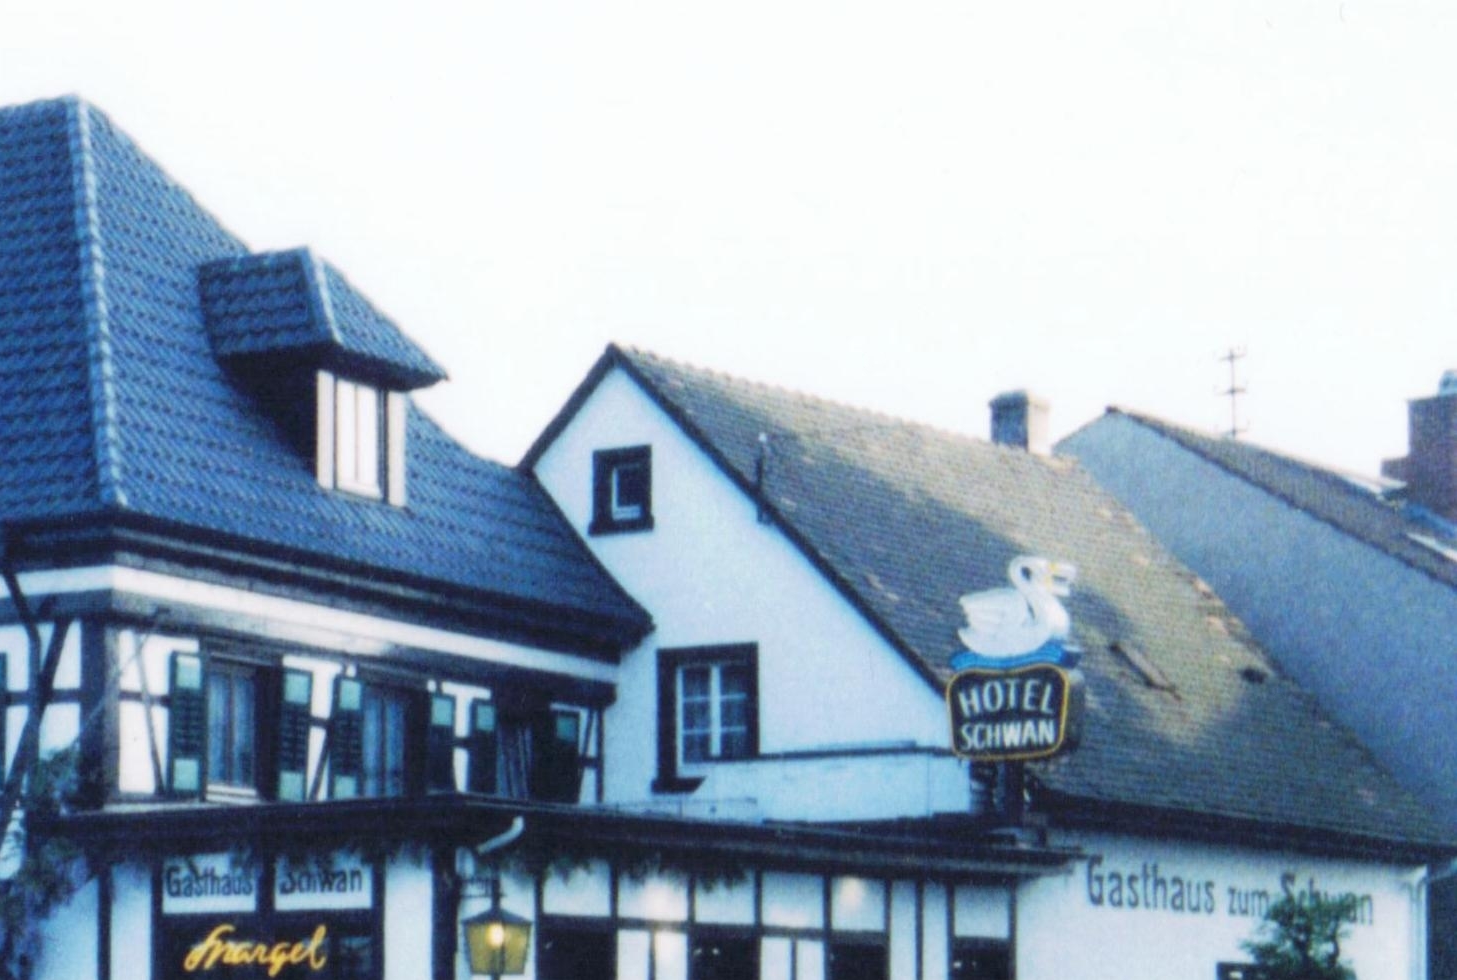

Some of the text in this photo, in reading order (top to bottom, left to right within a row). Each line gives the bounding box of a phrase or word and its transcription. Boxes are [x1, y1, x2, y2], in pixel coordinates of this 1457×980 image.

[958, 677, 1054, 718] HOTEL
[961, 719, 1056, 750] SCHWAN
[165, 864, 254, 898] Gasthaus
[1087, 854, 1216, 914] Gasthaus
[1228, 885, 1271, 917] zum
